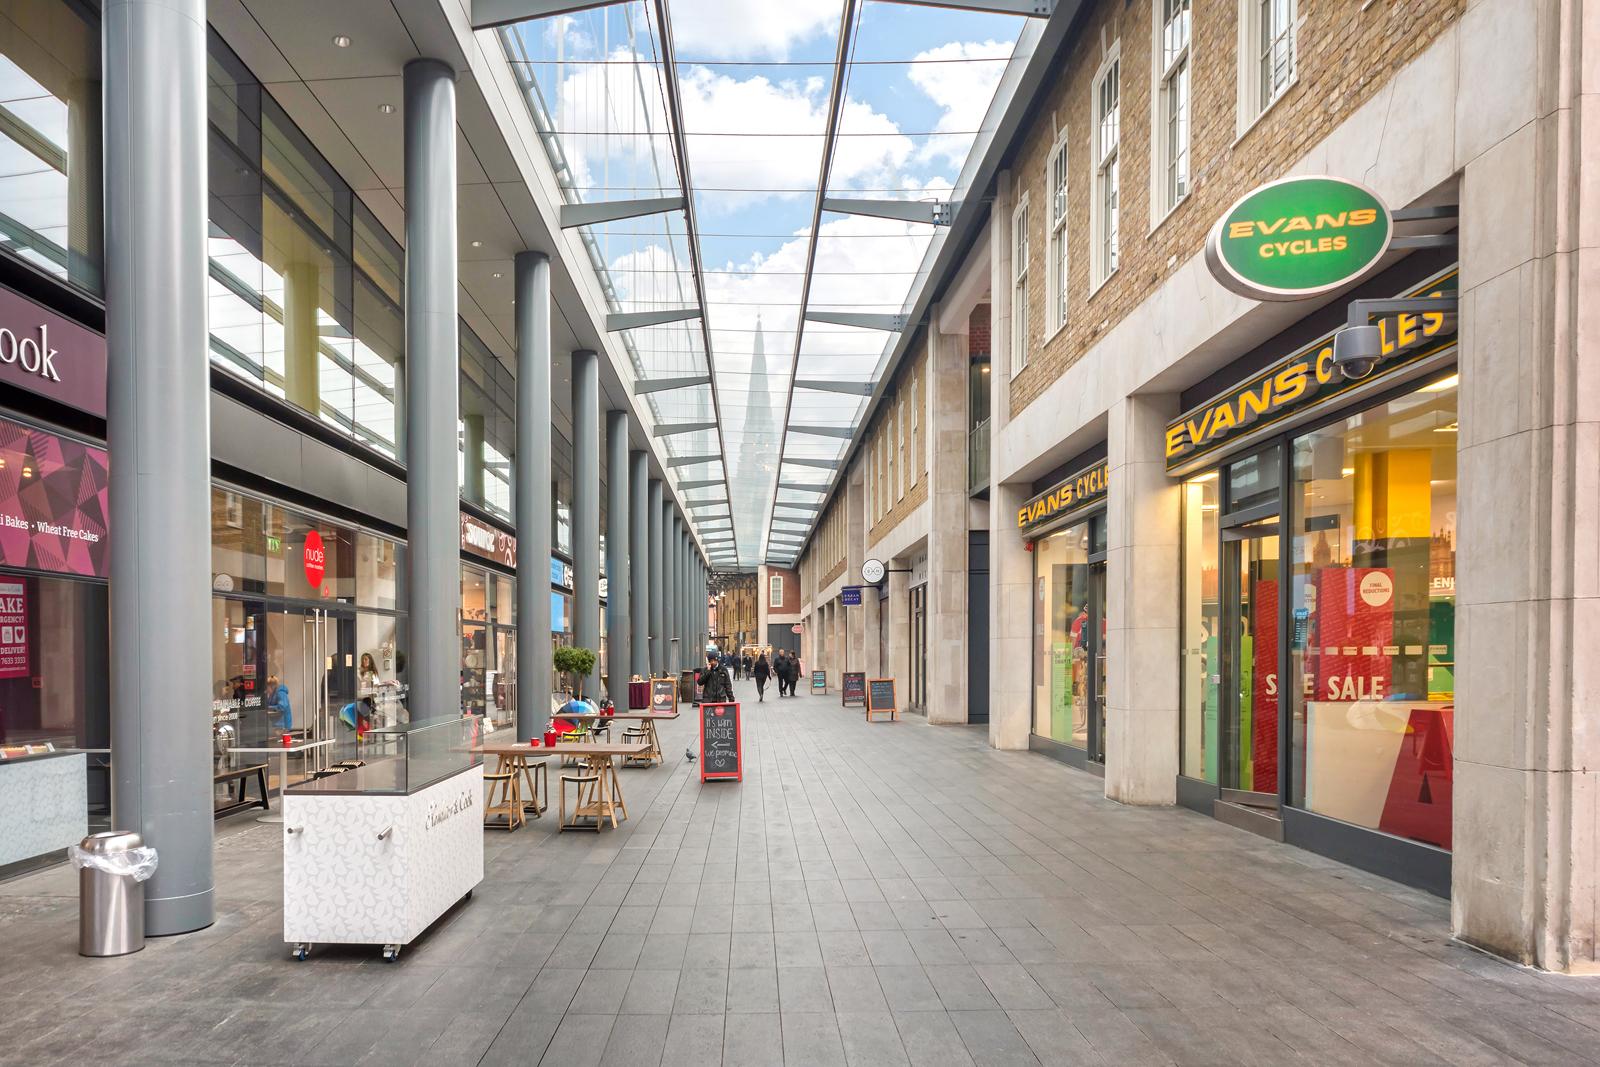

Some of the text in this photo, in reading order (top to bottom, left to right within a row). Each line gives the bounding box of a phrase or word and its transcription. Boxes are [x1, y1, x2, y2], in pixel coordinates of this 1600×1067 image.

[1229, 208, 1377, 239] EVANS
[1259, 235, 1348, 259] CYCLES
[1166, 291, 1445, 458] EVANS CLES
[1018, 484, 1074, 528] EVANS
[5, 515, 29, 530] Bakes
[37, 521, 61, 536] Wheat
[63, 526, 79, 539] Free
[79, 529, 99, 543] Cakes
[305, 548, 324, 563] nude
[1327, 675, 1385, 701] SALE
[706, 728, 734, 740] INSIDE
